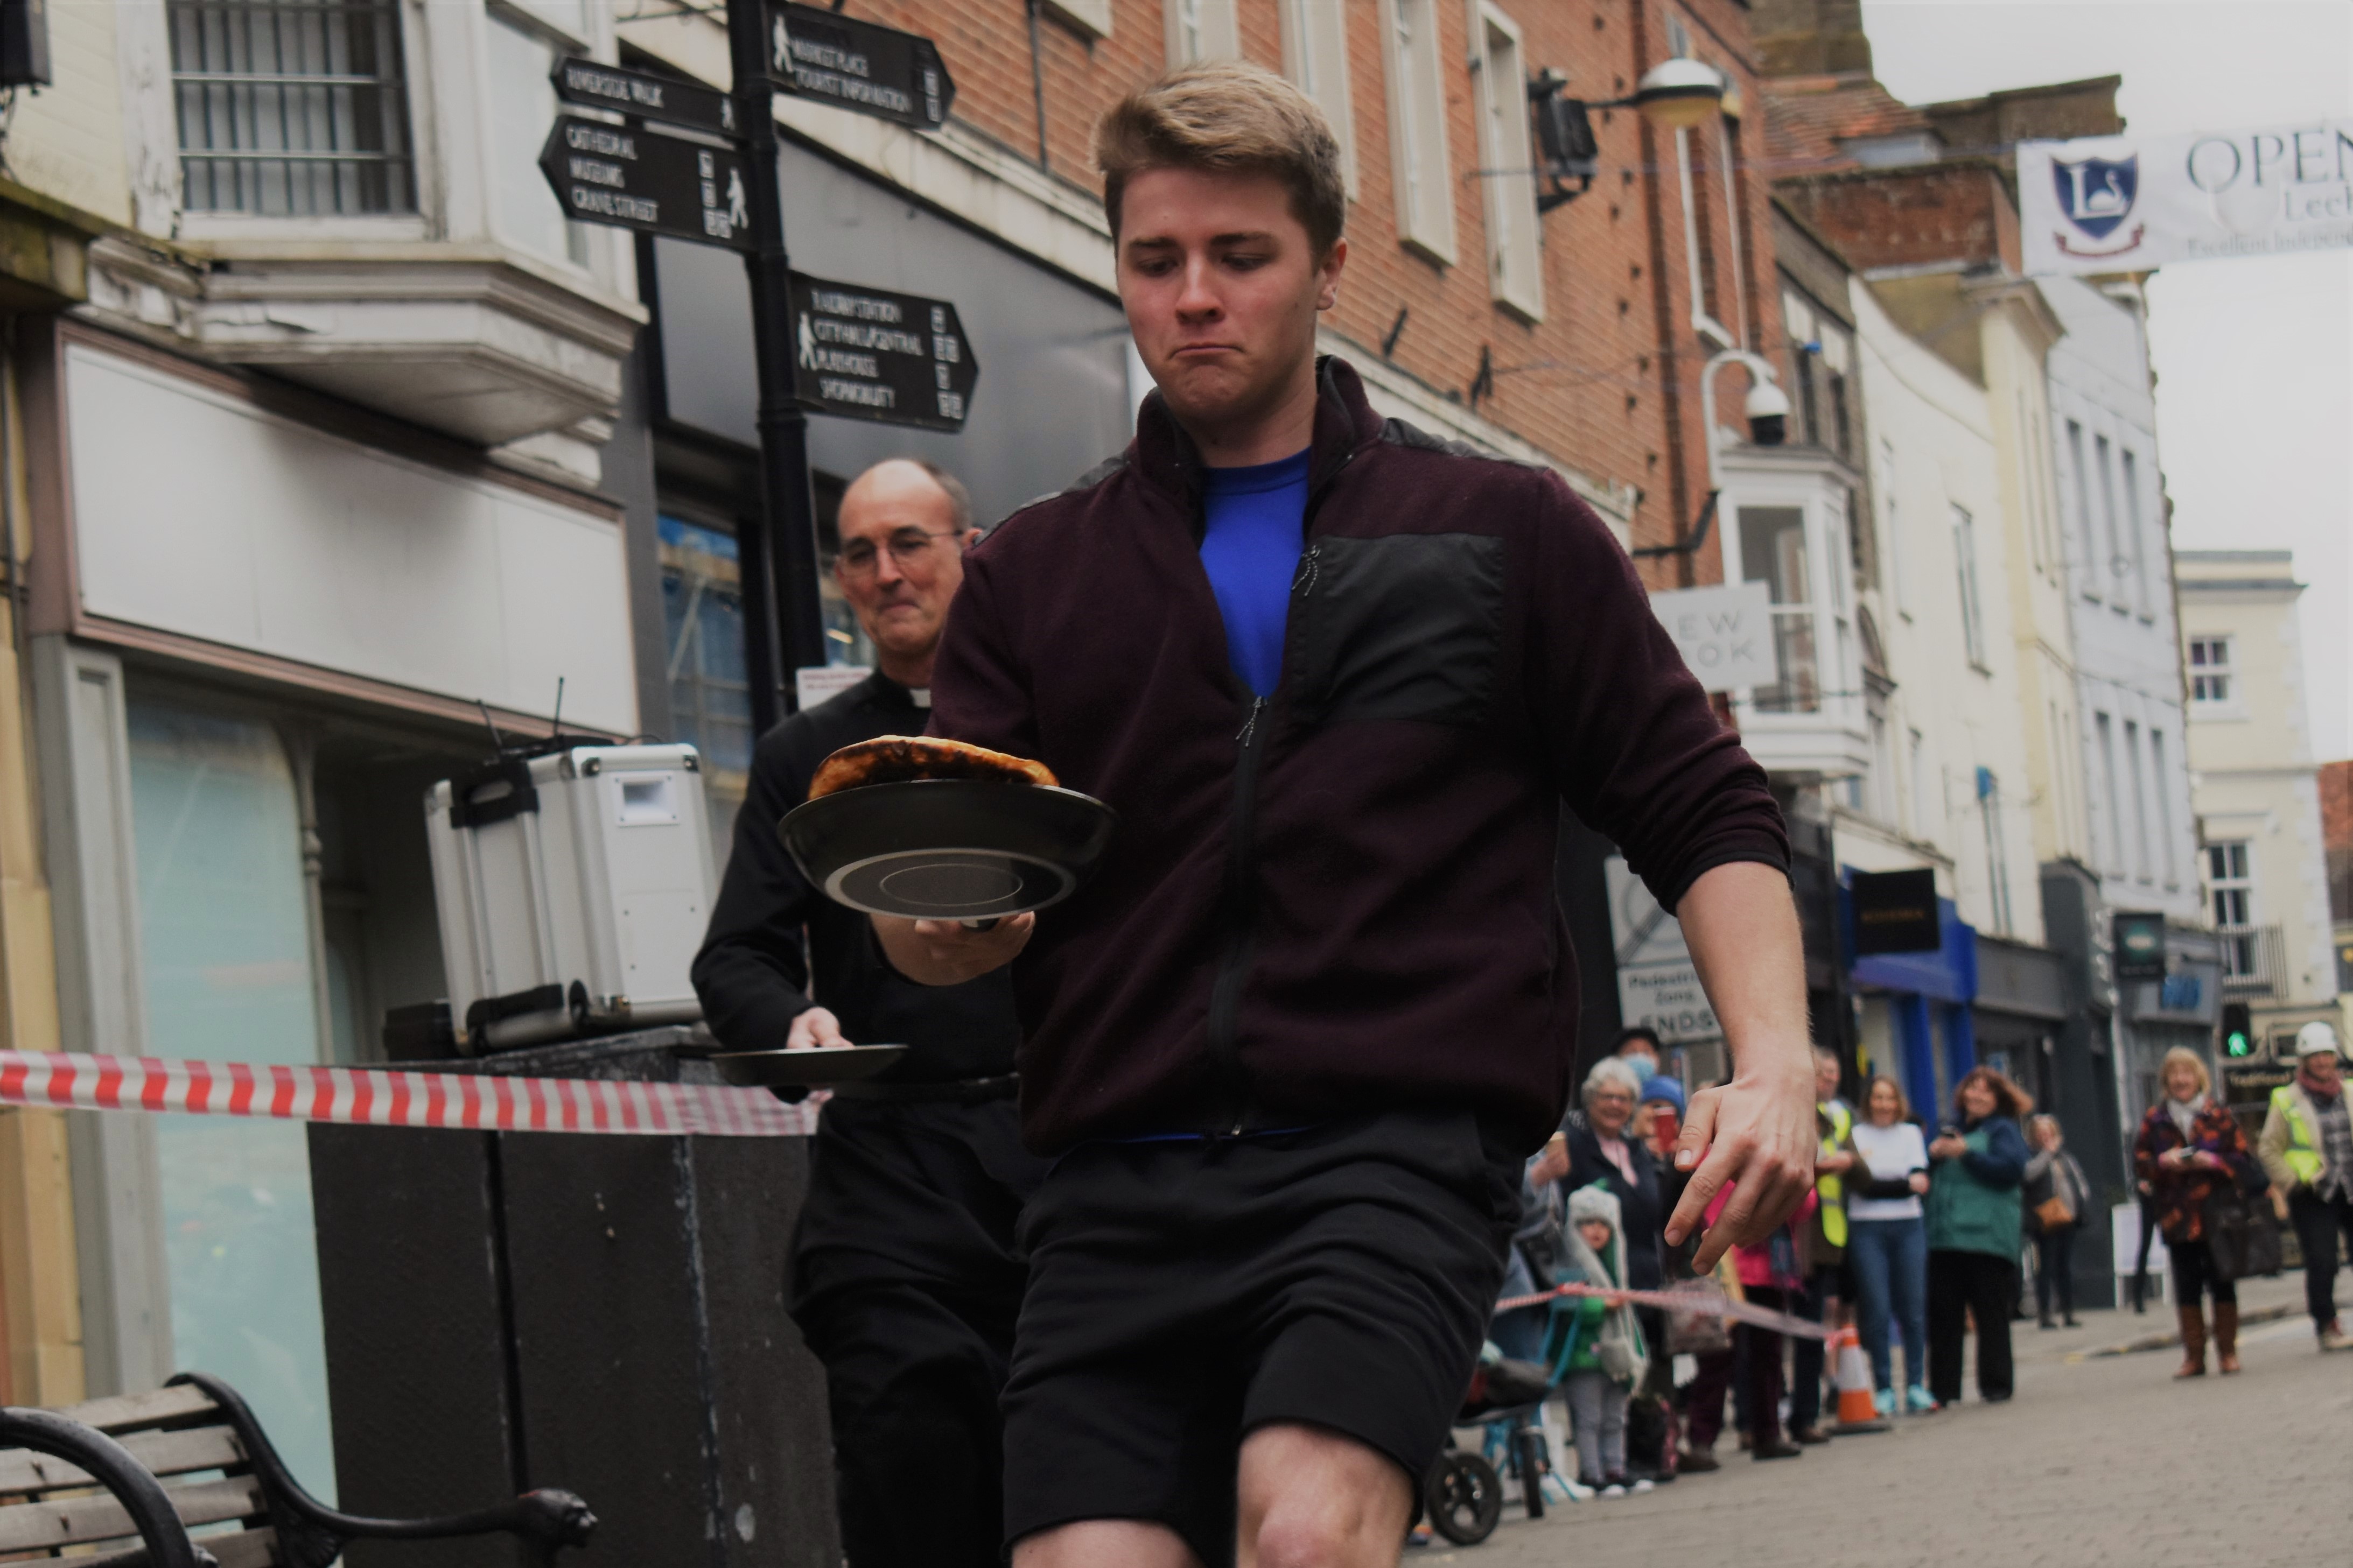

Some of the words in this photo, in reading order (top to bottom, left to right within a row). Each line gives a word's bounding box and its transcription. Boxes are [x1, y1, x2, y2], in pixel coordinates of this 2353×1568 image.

[631, 79, 664, 108] WALK
[566, 124, 638, 160] CATHEDRAL
[615, 193, 660, 222] STREET
[1677, 608, 1741, 641] EW
